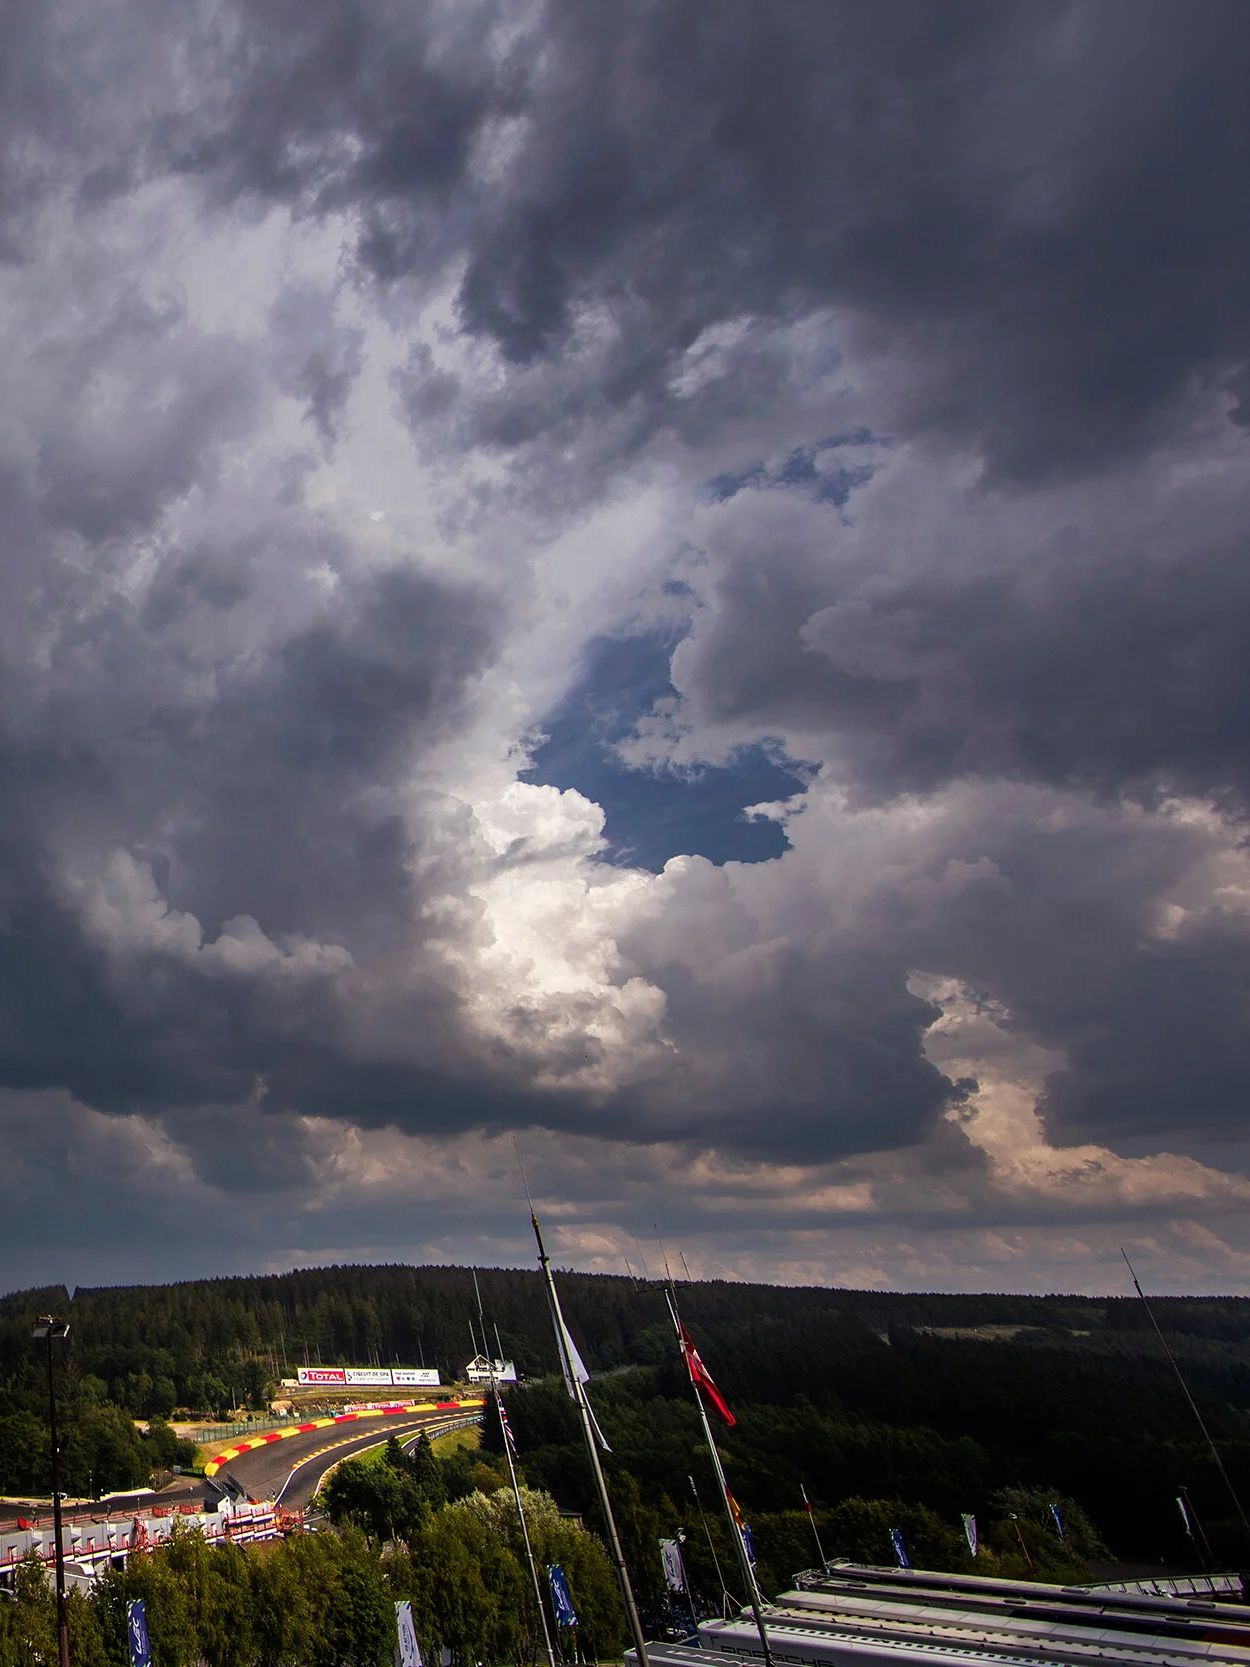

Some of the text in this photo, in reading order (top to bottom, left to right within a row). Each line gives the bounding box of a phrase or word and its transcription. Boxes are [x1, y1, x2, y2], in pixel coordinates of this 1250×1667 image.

[310, 1371, 343, 1380] TOTAL
[132, 1616, 143, 1655] WEC
[721, 1646, 835, 1667] PORSCHE
